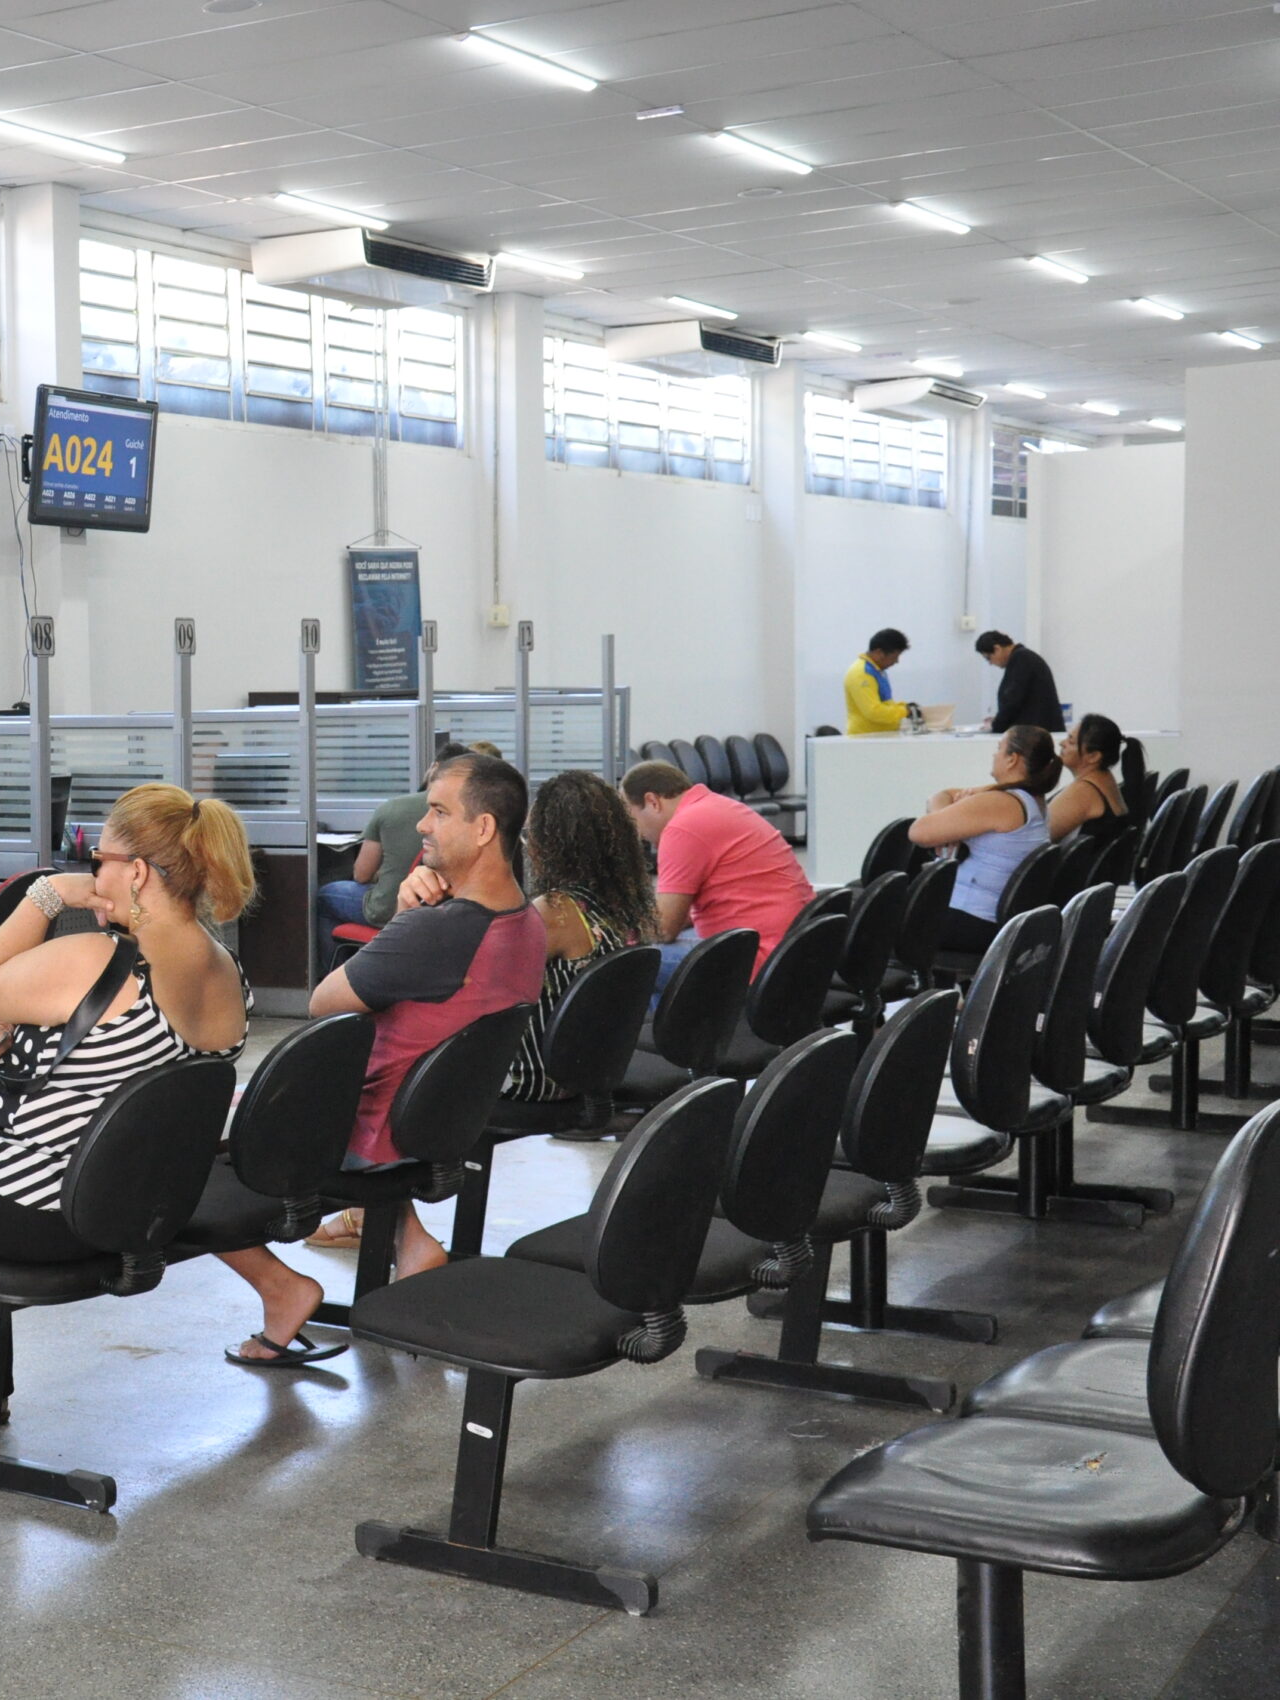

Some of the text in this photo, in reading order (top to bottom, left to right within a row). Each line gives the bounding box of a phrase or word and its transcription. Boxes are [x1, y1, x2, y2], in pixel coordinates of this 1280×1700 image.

[48, 407, 90, 424] Atendimento
[42, 433, 113, 477] A024
[125, 438, 145, 450] Guichê
[129, 456, 137, 478] 1
[34, 622, 52, 651] 08
[178, 623, 194, 649] 09
[304, 624, 318, 648] 10
[425, 626, 434, 648] 11
[521, 625, 532, 647] 12
